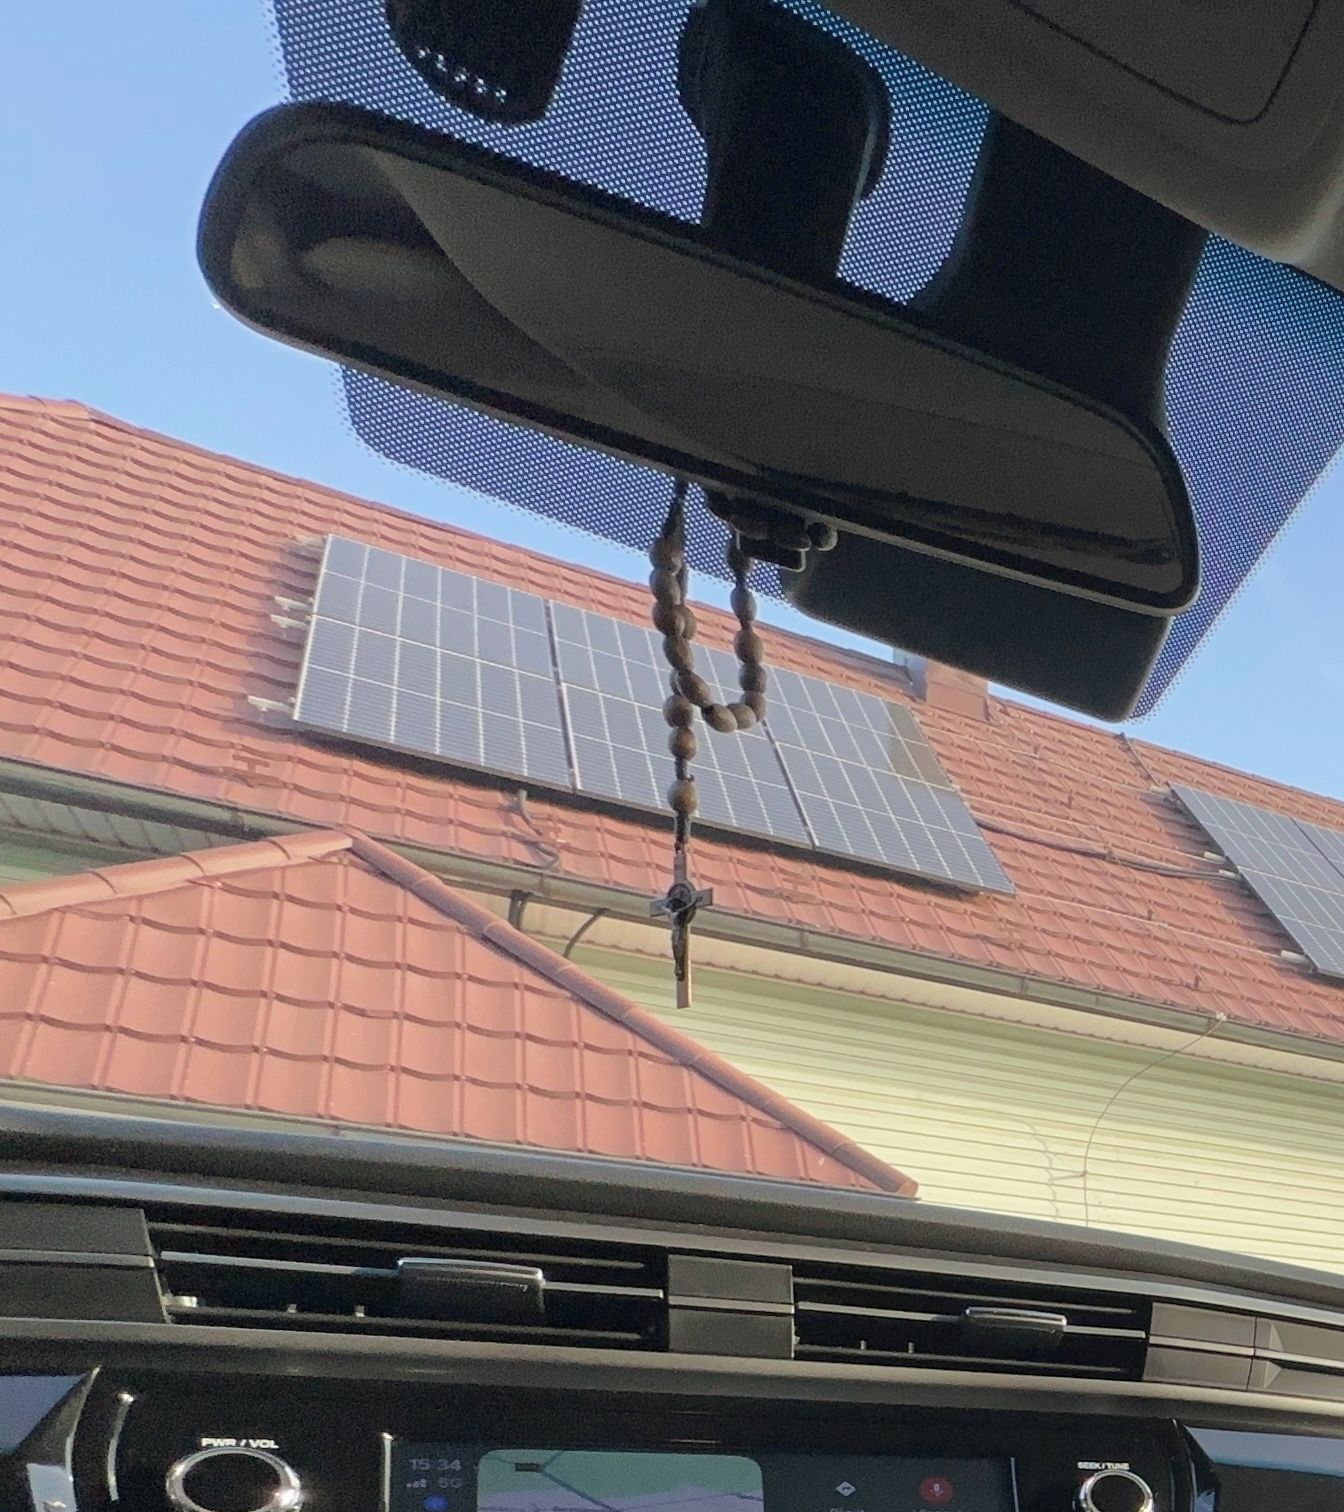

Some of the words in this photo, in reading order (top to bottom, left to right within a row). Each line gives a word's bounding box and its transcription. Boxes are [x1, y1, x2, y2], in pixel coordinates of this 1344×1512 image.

[201, 1437, 236, 1449] PWR
[249, 1438, 280, 1449] VOL
[408, 1458, 463, 1472] 1534
[1106, 1462, 1130, 1471] TUNE
[438, 1477, 464, 1489] 5G
